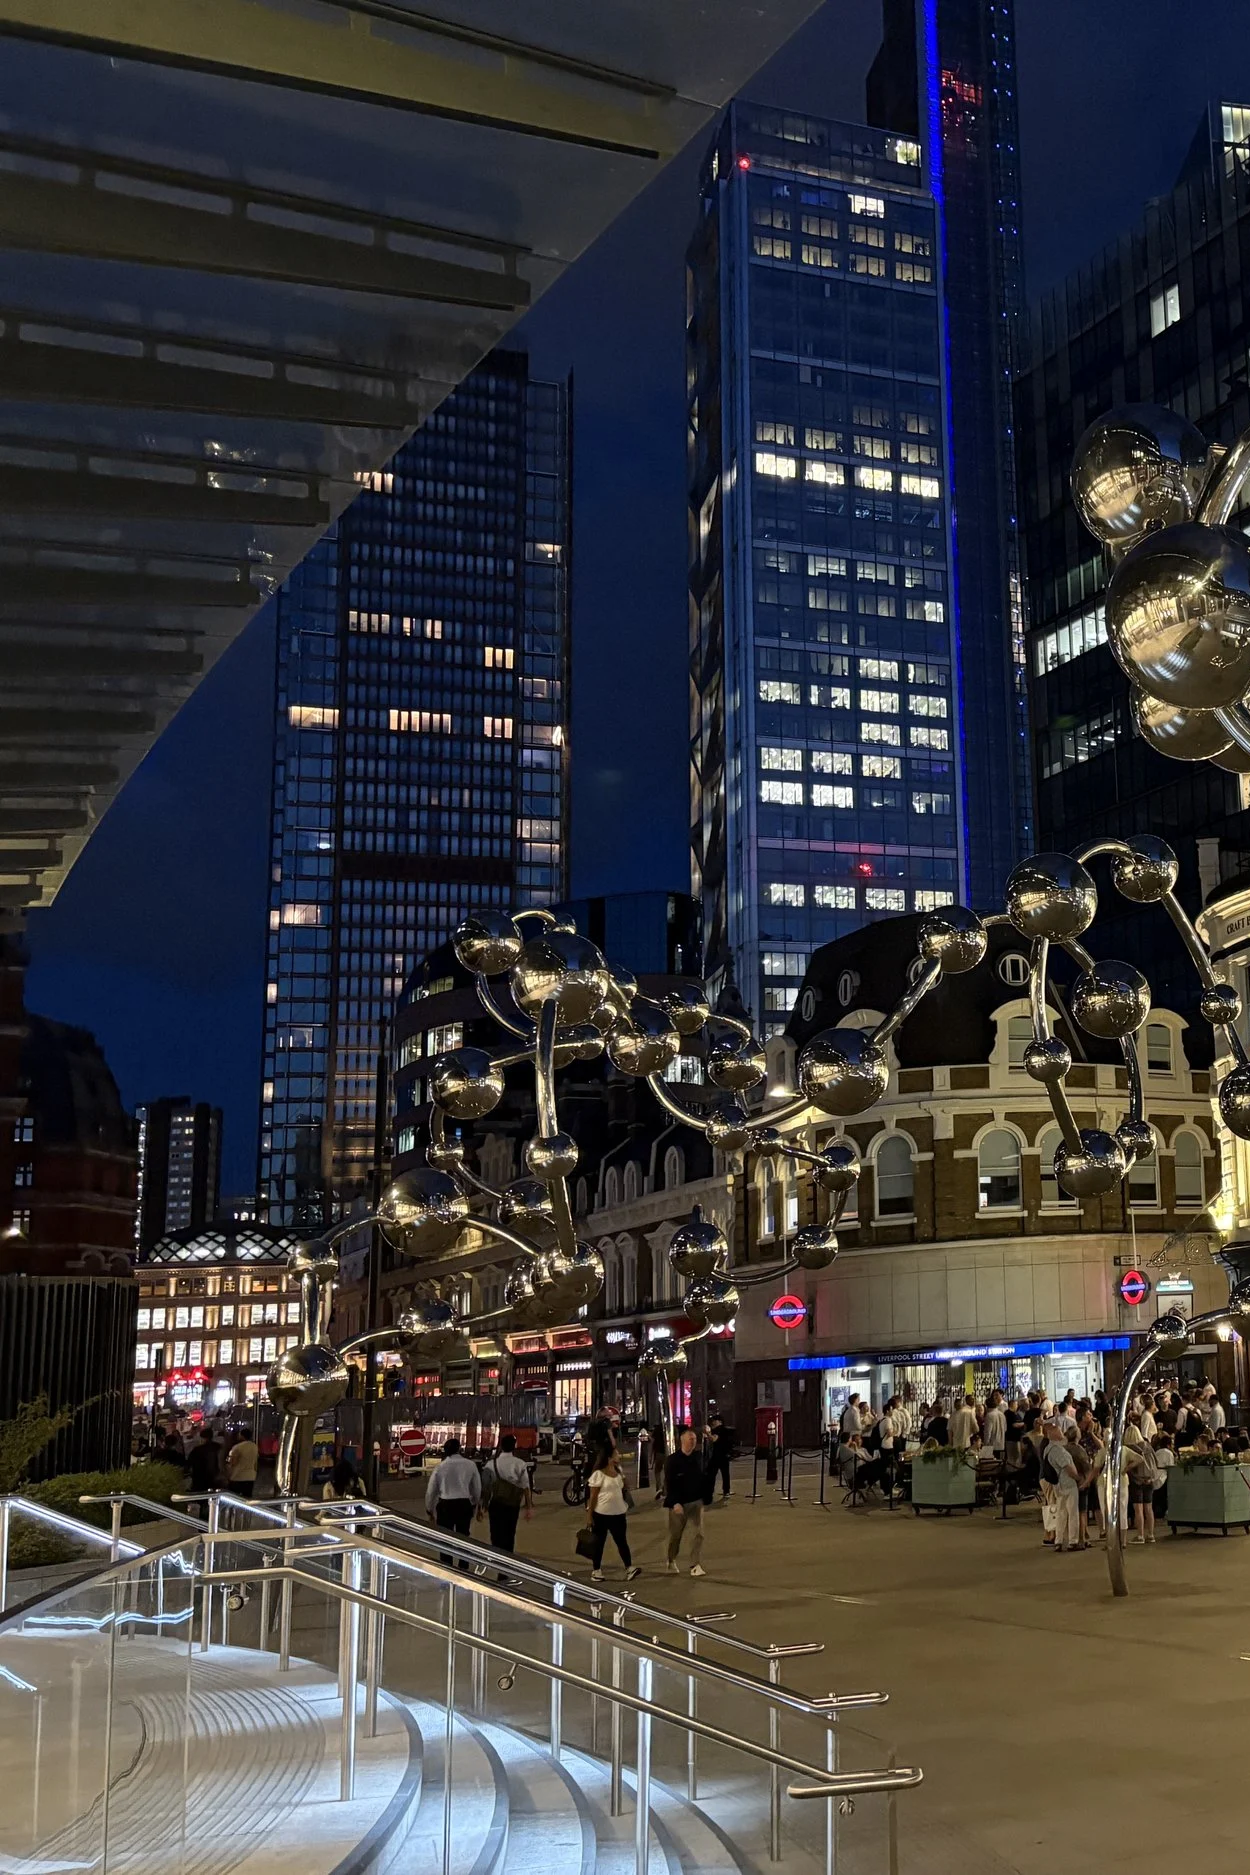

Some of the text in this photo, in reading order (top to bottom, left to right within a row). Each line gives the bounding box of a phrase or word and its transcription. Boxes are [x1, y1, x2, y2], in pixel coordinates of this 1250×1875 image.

[1226, 917, 1245, 935] CRAFT
[878, 1354, 911, 1362] LIVERPOOL
[935, 1348, 987, 1359] UNDERGROUND
[988, 1346, 1015, 1356] STATION
